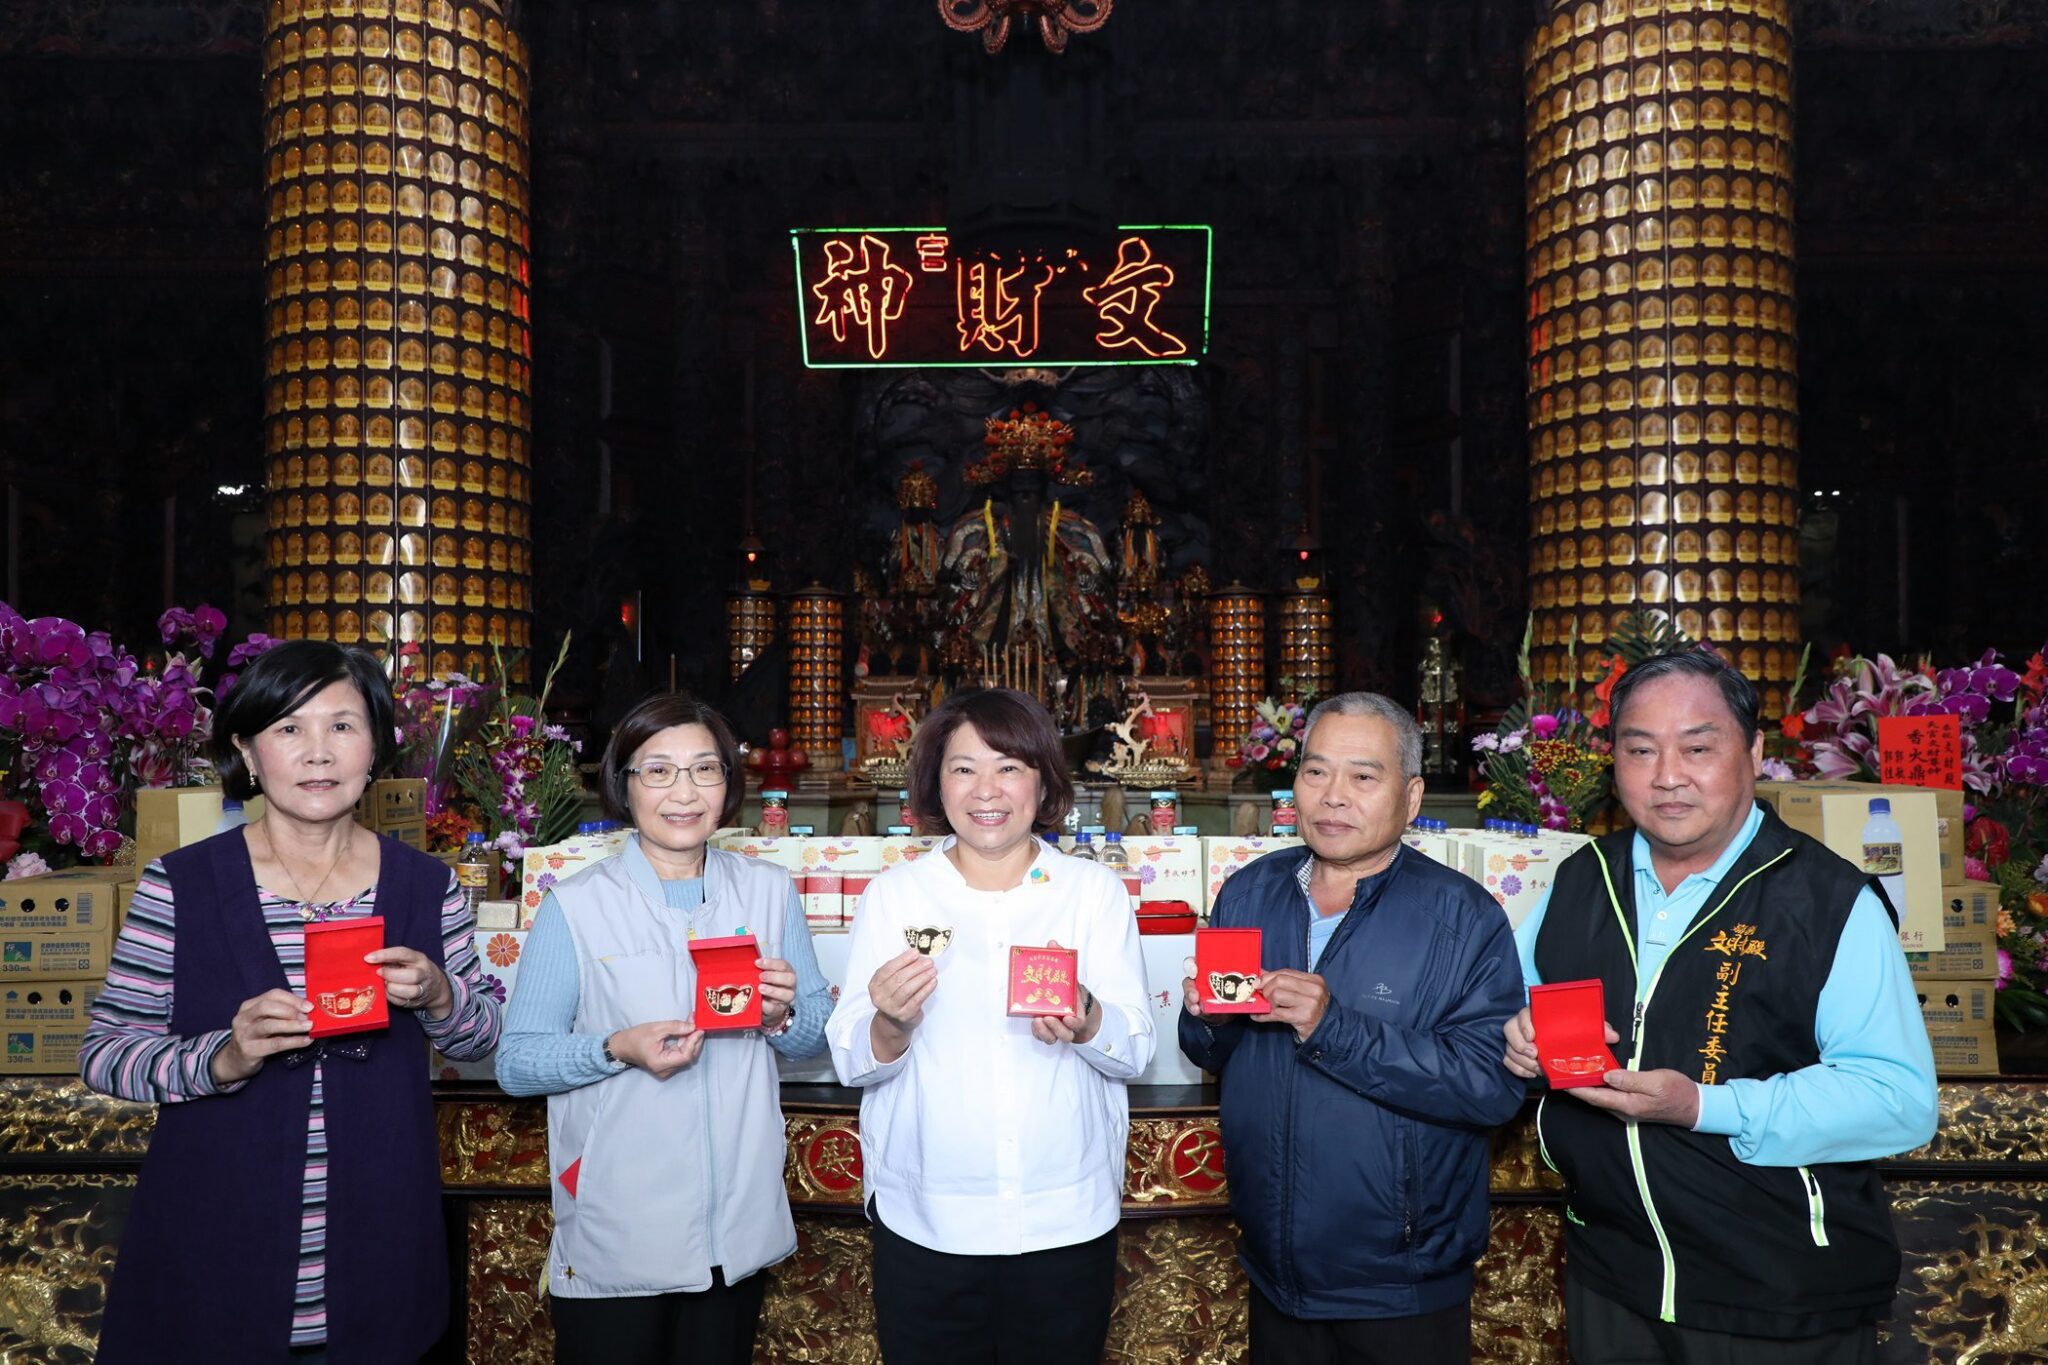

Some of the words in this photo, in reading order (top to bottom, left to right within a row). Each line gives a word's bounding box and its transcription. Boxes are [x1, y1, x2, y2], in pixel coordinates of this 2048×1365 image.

[1906, 728, 1928, 786] 香火鼎
[1698, 961, 1742, 1086] 副主任委員
[813, 1138, 861, 1183] 殿
[1179, 1133, 1225, 1181] 文
